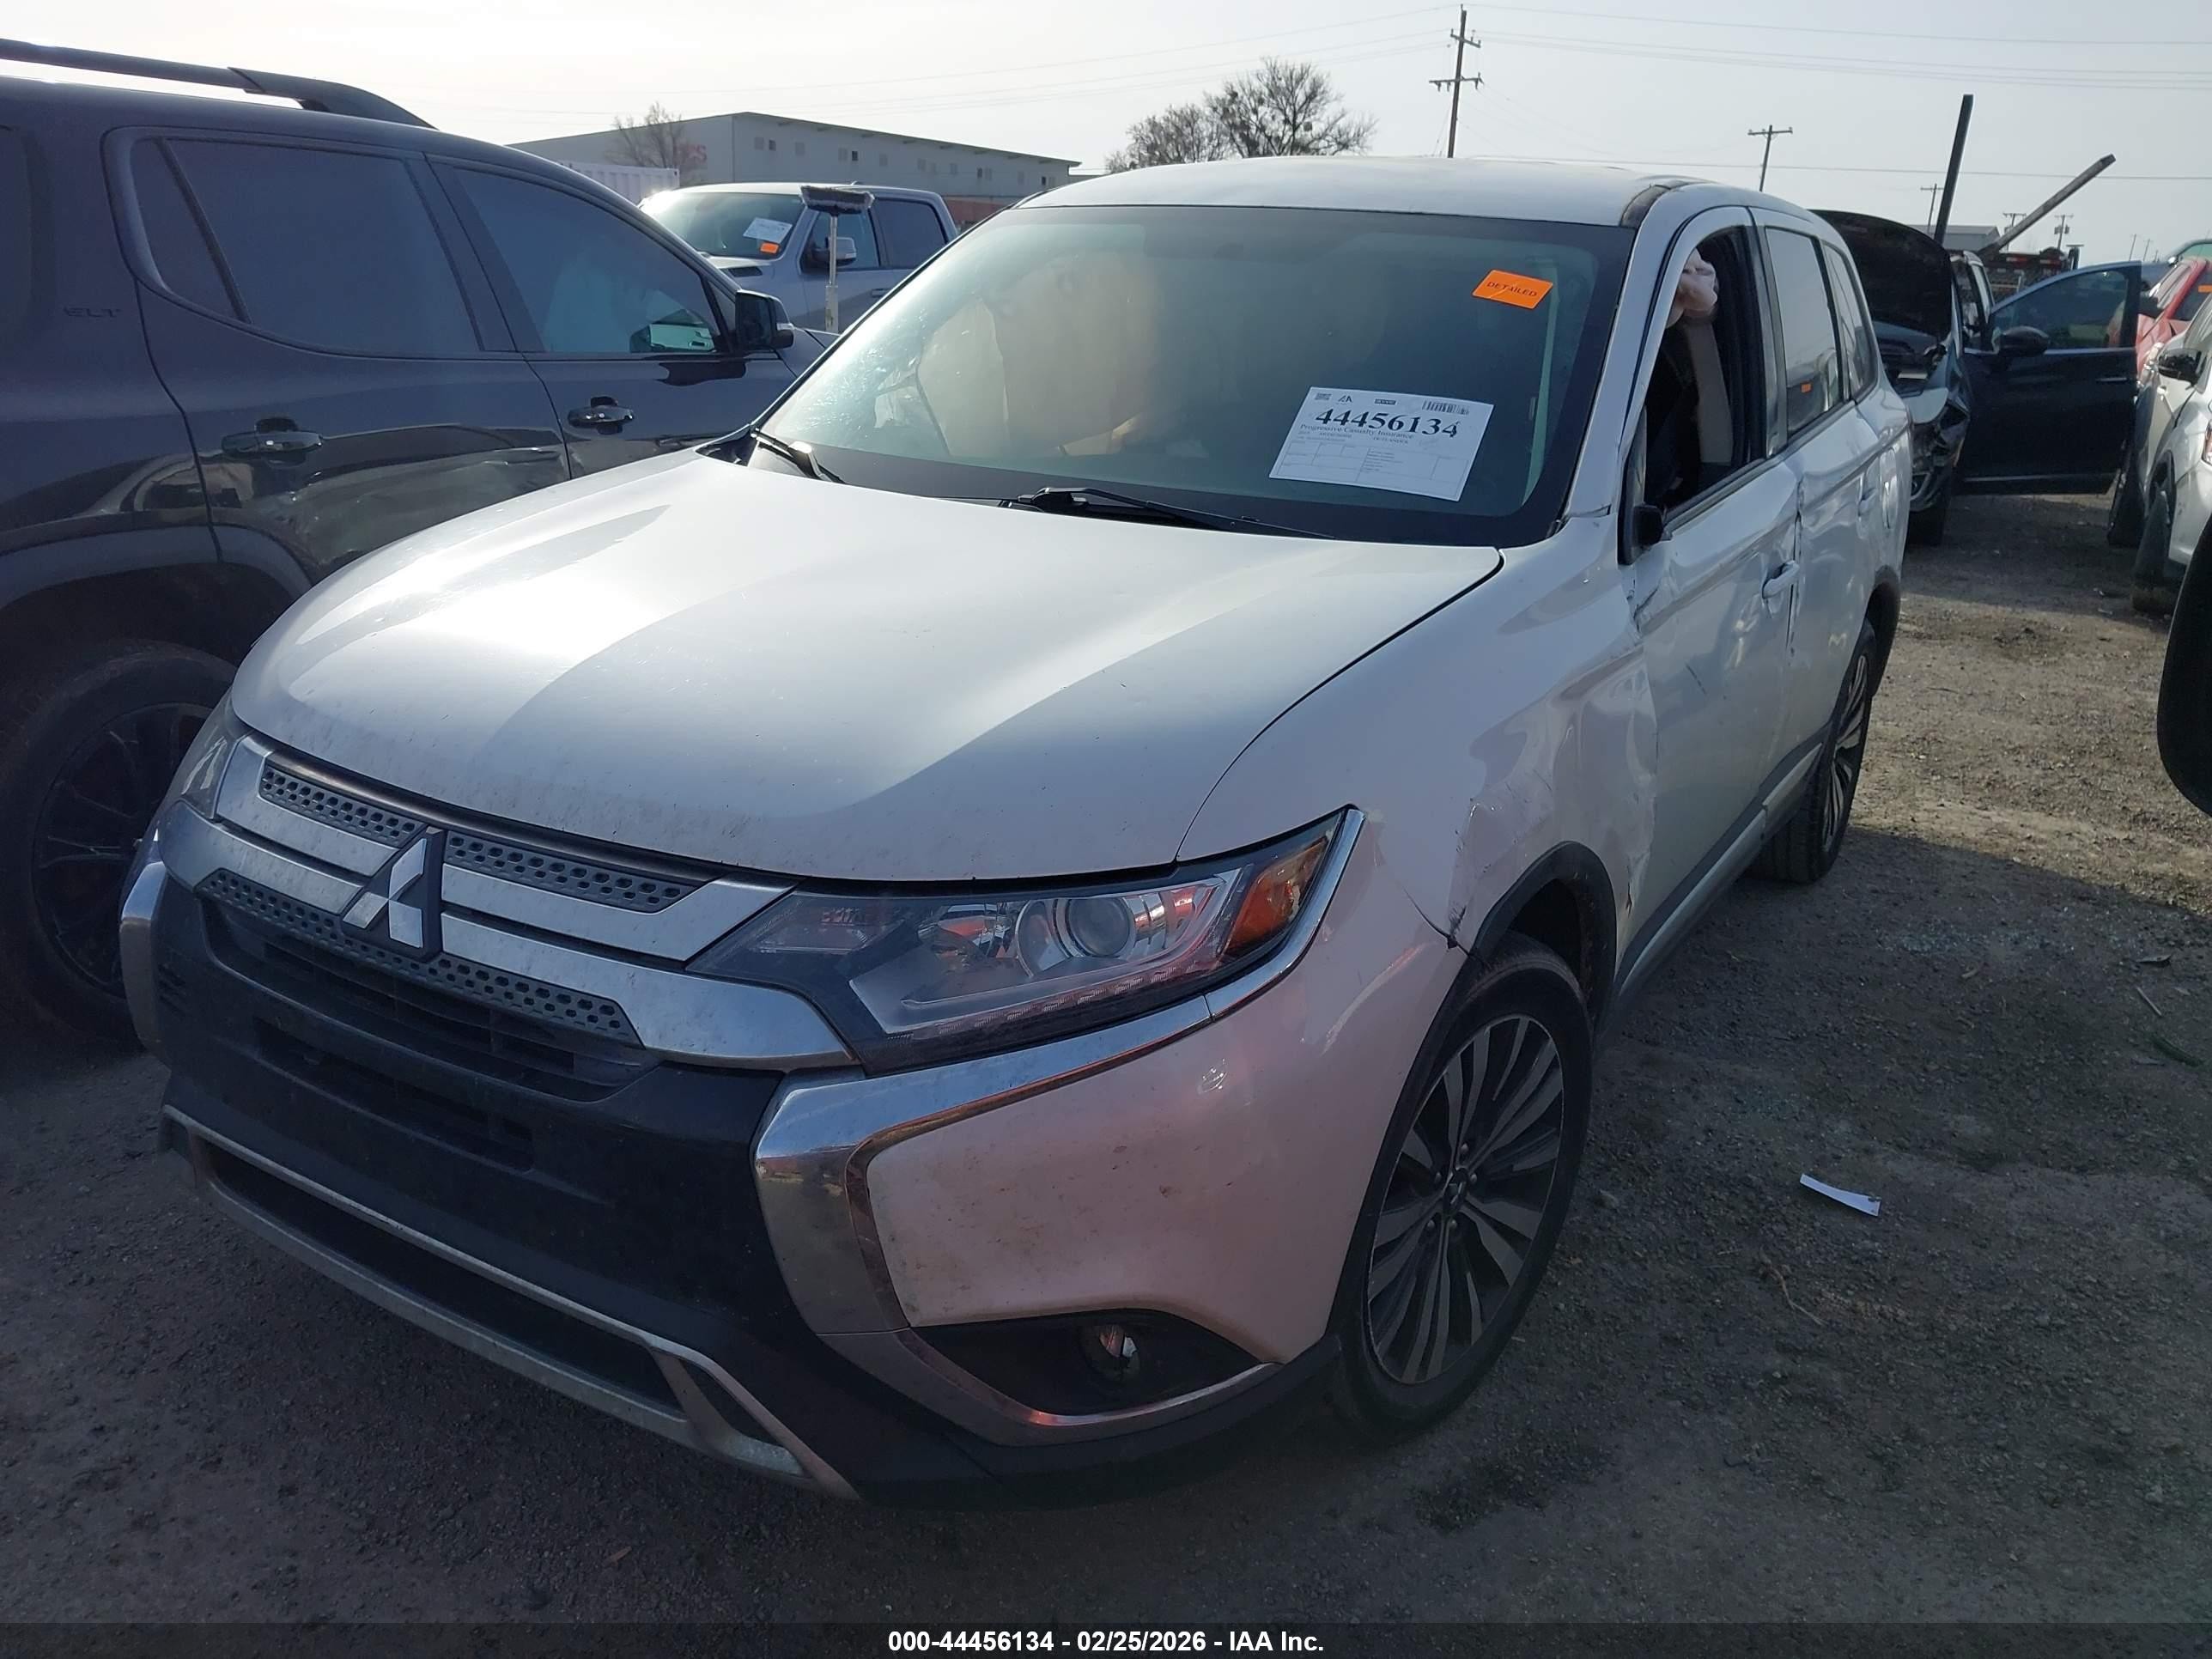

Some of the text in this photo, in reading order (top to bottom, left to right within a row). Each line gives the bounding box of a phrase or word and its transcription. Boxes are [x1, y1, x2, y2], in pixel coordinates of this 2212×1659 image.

[1486, 281, 1537, 297] DETAILED
[1315, 408, 1461, 438] 44456134
[1300, 424, 1341, 433] Progressive
[1344, 427, 1374, 435] Casualty
[1378, 430, 1413, 439] Insurance
